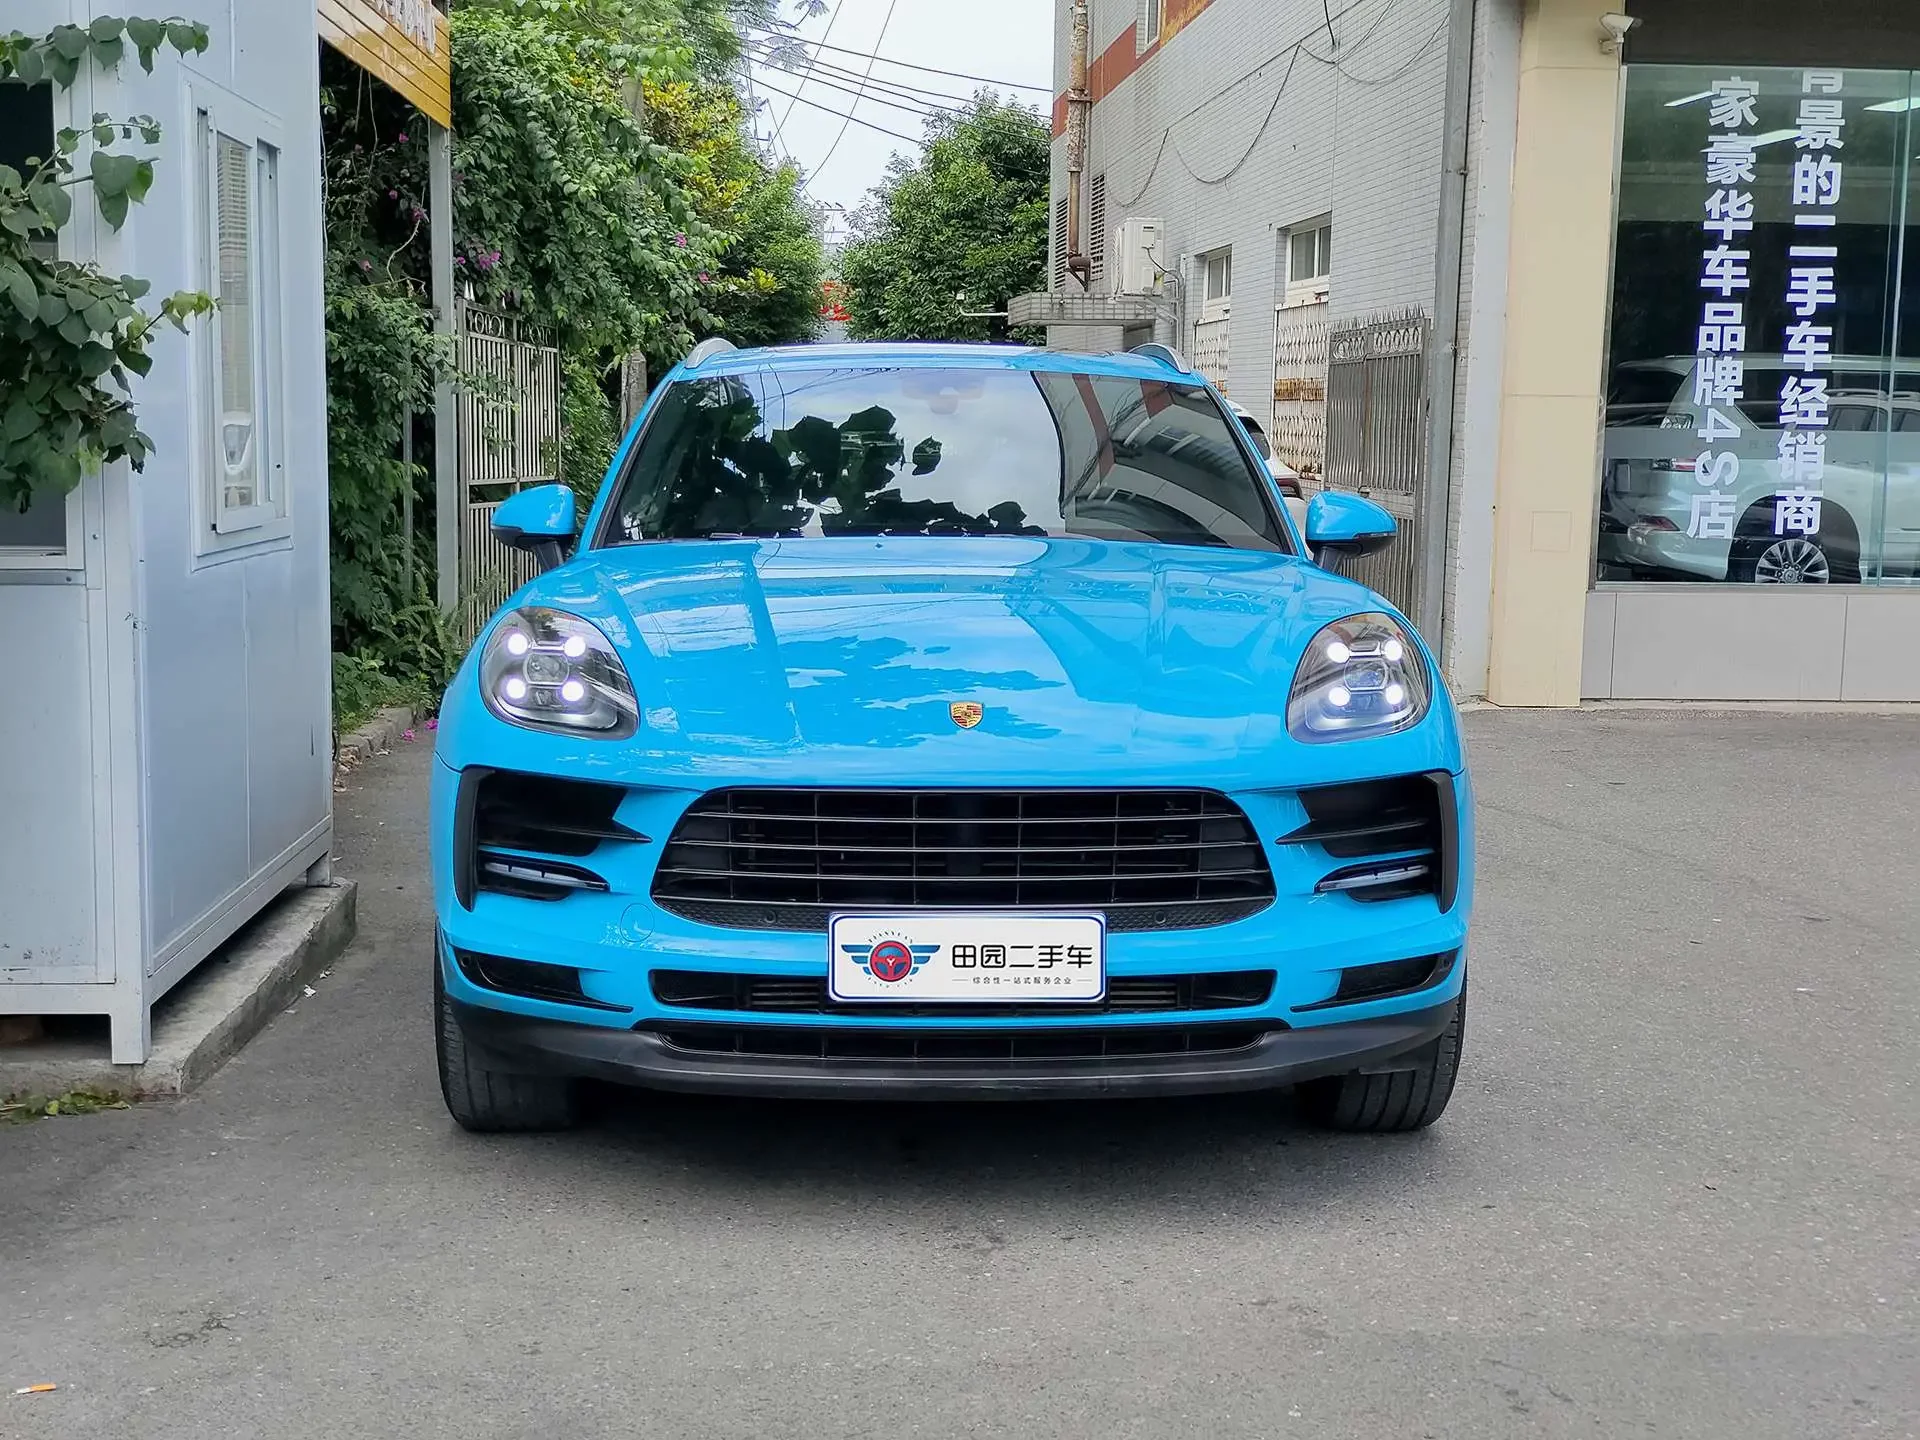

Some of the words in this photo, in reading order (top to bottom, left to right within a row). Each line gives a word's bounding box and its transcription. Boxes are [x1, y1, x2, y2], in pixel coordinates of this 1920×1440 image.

[1688, 76, 1760, 539] 家豪华车品牌4S店
[952, 944, 1093, 969] 田园二手车
[972, 976, 1072, 985] 综合性一站式服务企业
